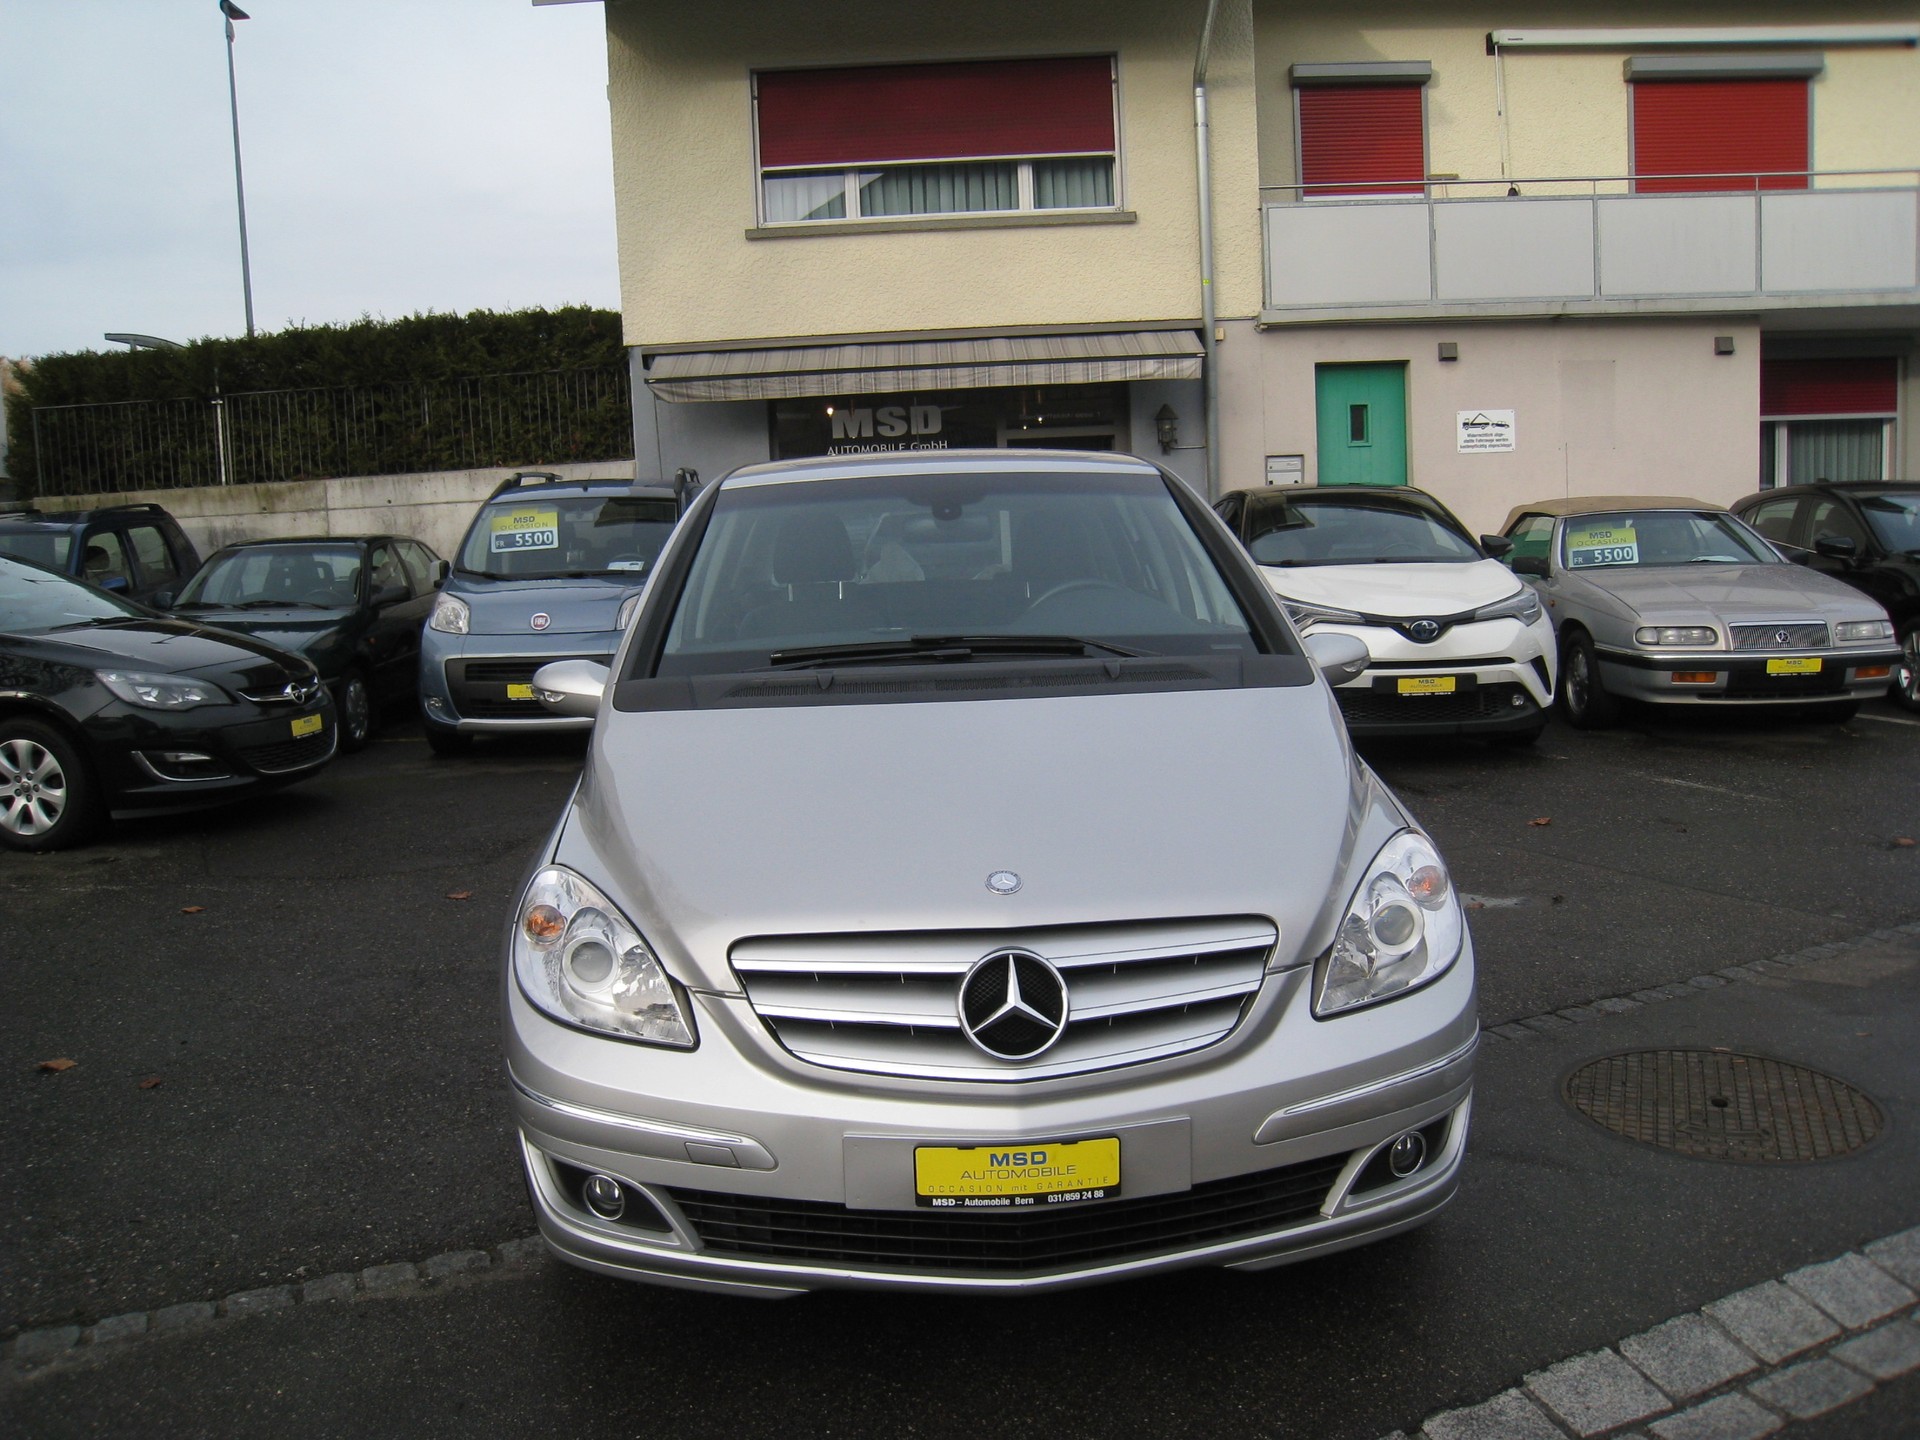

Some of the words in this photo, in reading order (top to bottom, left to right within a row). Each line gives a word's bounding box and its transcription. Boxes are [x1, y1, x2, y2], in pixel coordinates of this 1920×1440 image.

[831, 405, 942, 439] MSD
[910, 440, 948, 451] GmbH
[499, 521, 549, 531] OCCASION
[513, 516, 536, 524] MSD
[515, 531, 553, 546] 5500
[1576, 537, 1628, 547] OCCASION
[1589, 530, 1613, 540] MSD
[1594, 547, 1633, 563] 5500
[989, 1150, 1047, 1167] MSD
[960, 1165, 1077, 1180] AUTOMOBILE
[928, 1185, 1003, 1193] OCCASION
[1011, 1184, 1028, 1192] mit
[1036, 1176, 1109, 1190] GARANTIE
[964, 1197, 1011, 1206] Automobile
[1015, 1196, 1034, 1205] Bern
[1047, 1192, 1081, 1203] 031/859
[1082, 1190, 1092, 1200] 24
[1093, 1189, 1104, 1198] 88
